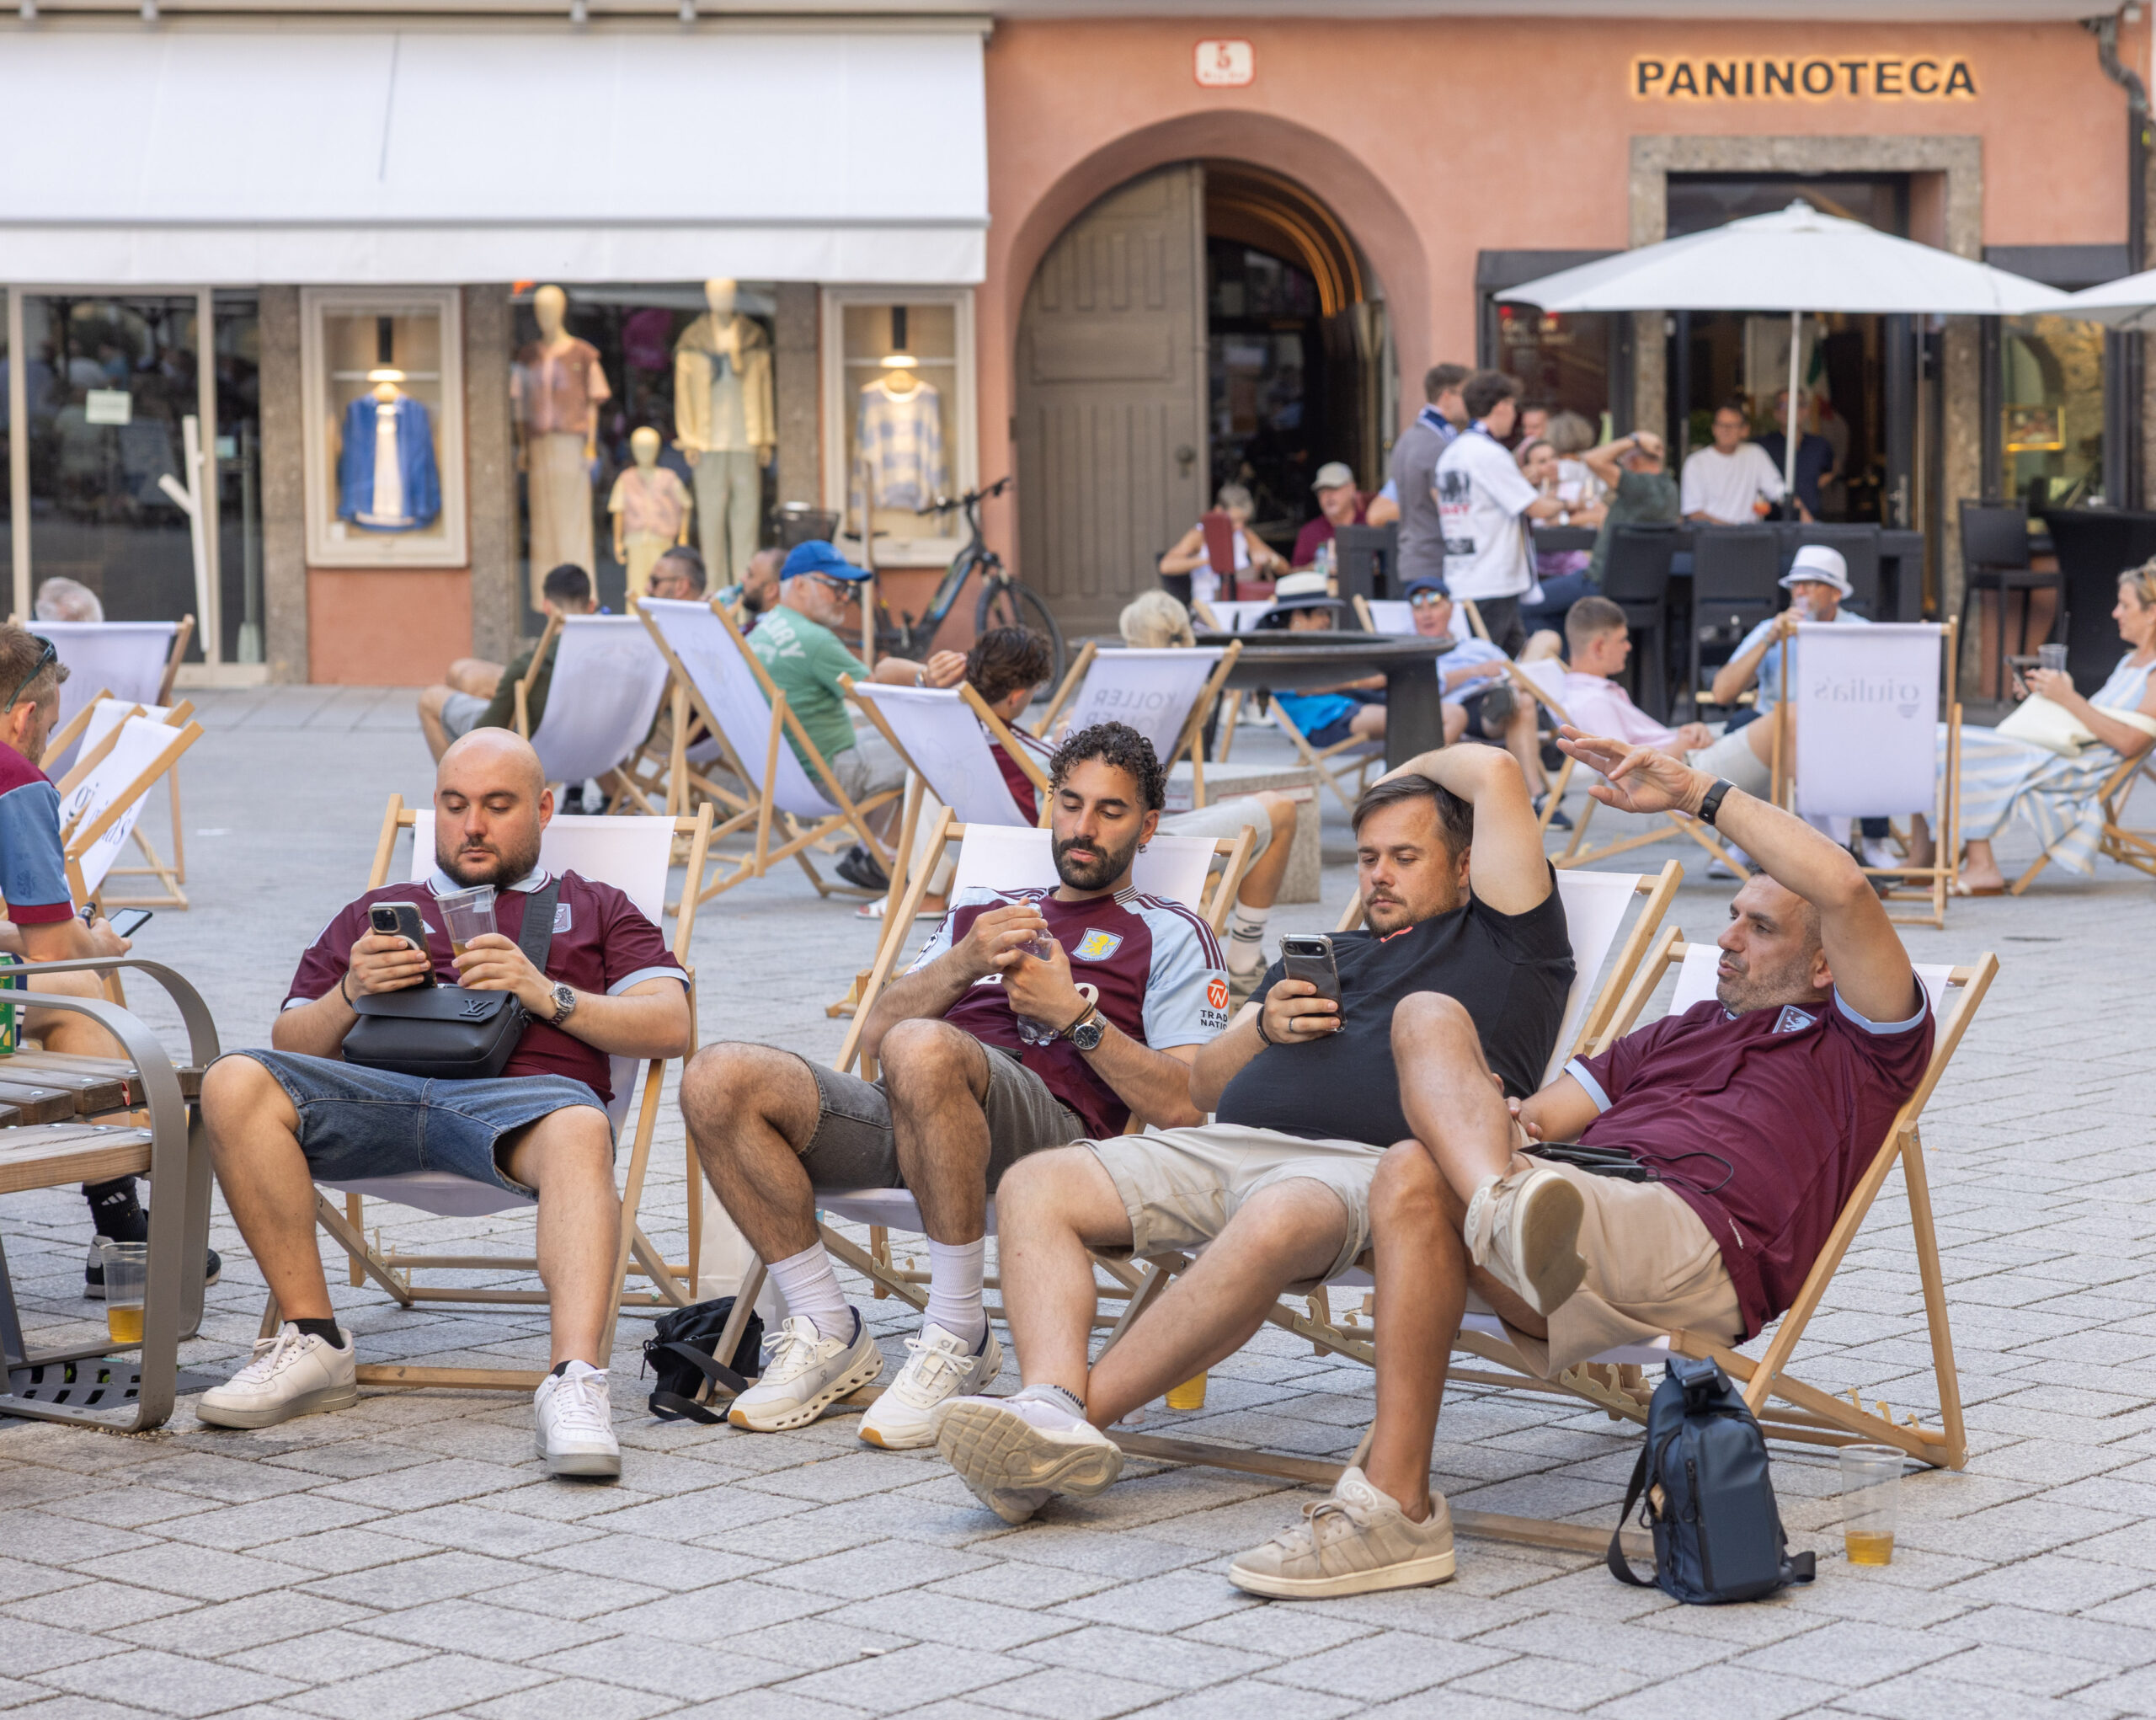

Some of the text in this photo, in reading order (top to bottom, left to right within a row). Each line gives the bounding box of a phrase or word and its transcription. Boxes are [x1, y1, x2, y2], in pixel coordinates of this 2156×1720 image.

[1216, 42, 1231, 69] 5
[1637, 61, 1977, 96] PANINOTECA
[1200, 1009, 1228, 1023] TRAD
[1200, 1018, 1227, 1030] NATIO
